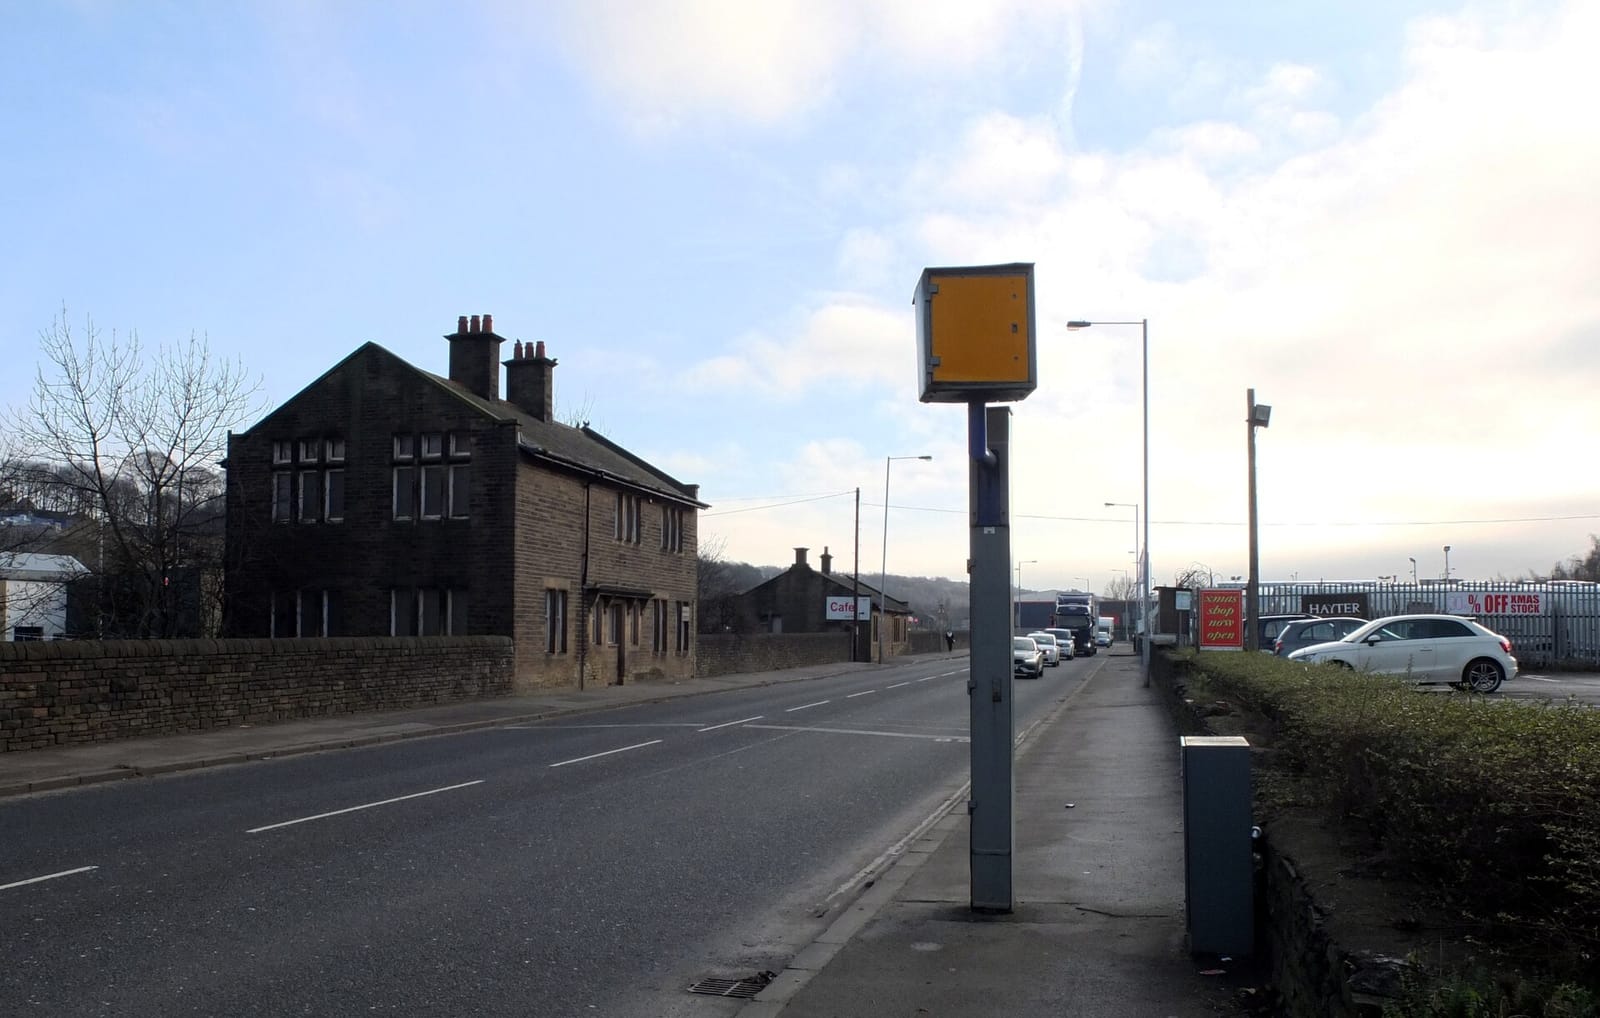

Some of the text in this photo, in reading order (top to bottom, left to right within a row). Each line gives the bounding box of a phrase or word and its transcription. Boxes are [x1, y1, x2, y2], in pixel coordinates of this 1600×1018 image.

[1484, 594, 1508, 613] OFF
[1511, 595, 1540, 604] XMAS
[1208, 605, 1234, 617] shop
[1309, 602, 1361, 614] HAYTER
[1511, 604, 1540, 613] STOCK
[1208, 619, 1235, 627] now
[1207, 632, 1235, 641] open
